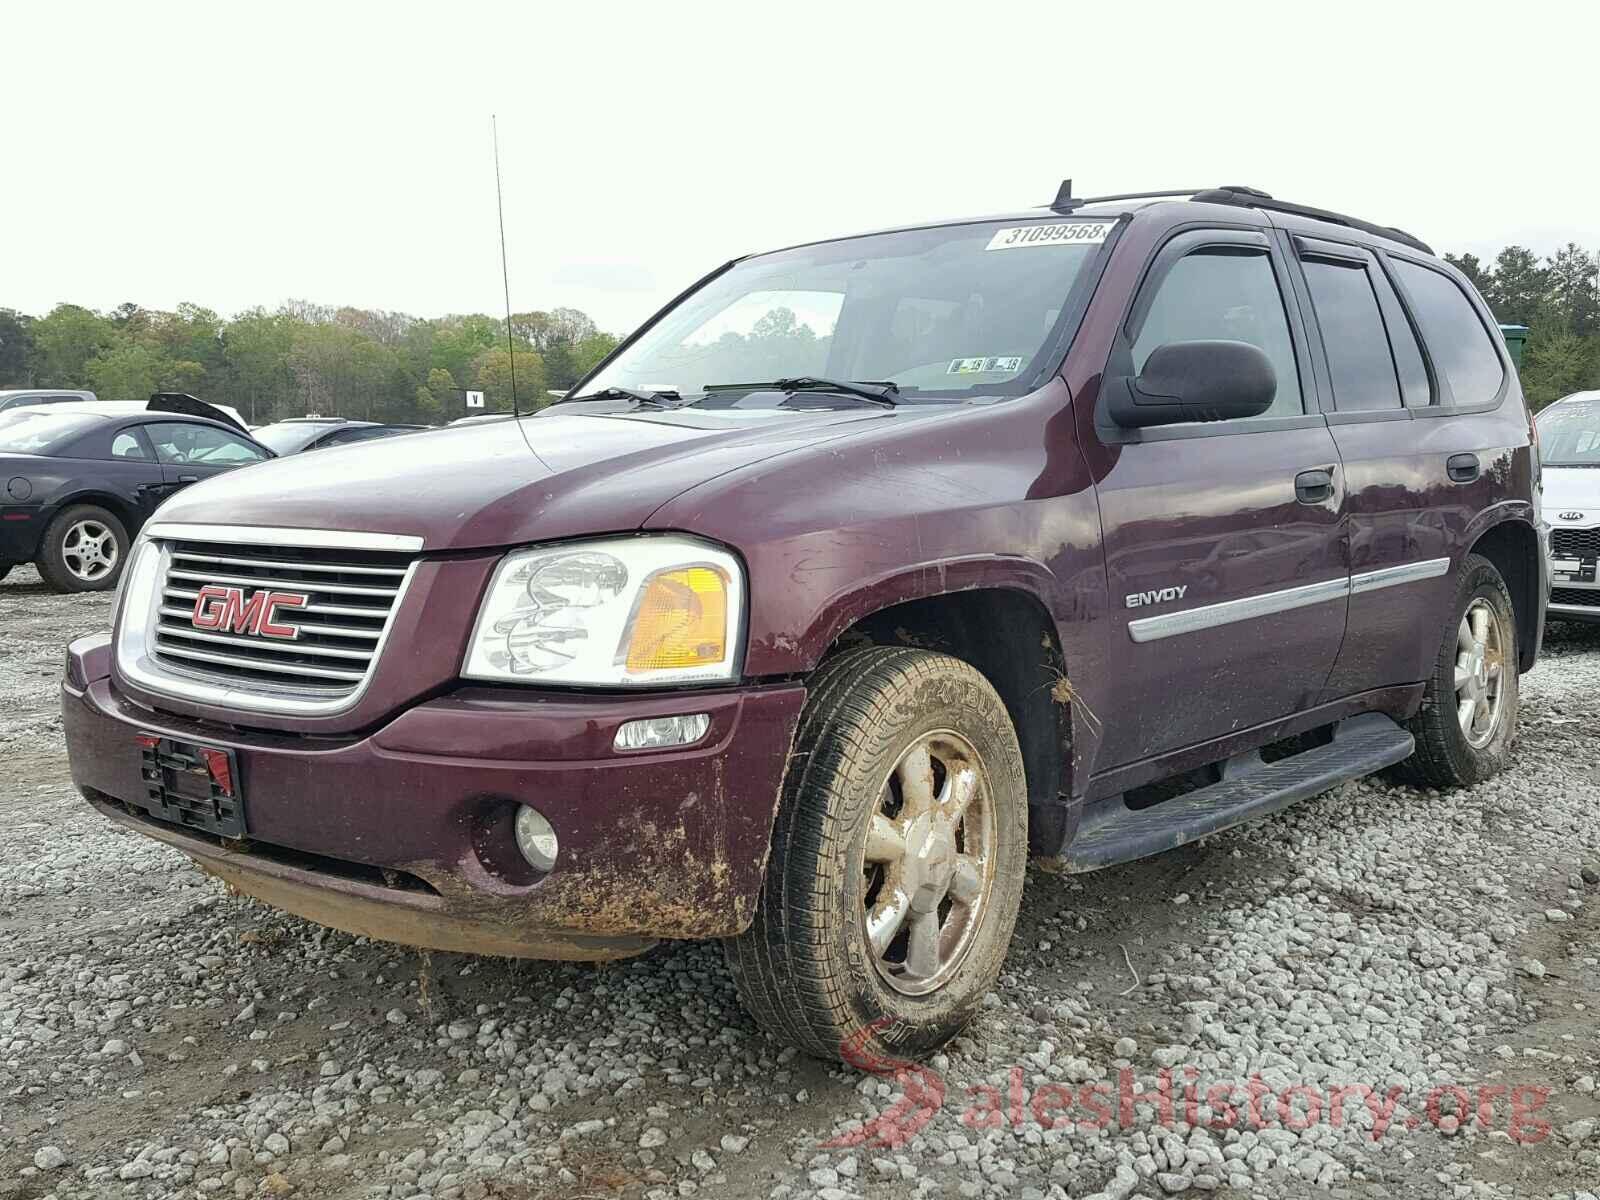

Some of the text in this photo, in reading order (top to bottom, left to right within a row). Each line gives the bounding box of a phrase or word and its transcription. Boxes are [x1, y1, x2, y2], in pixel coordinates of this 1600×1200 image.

[472, 394, 478, 405] V
[1126, 585, 1188, 608] ENVOY
[192, 585, 308, 640] GMC
